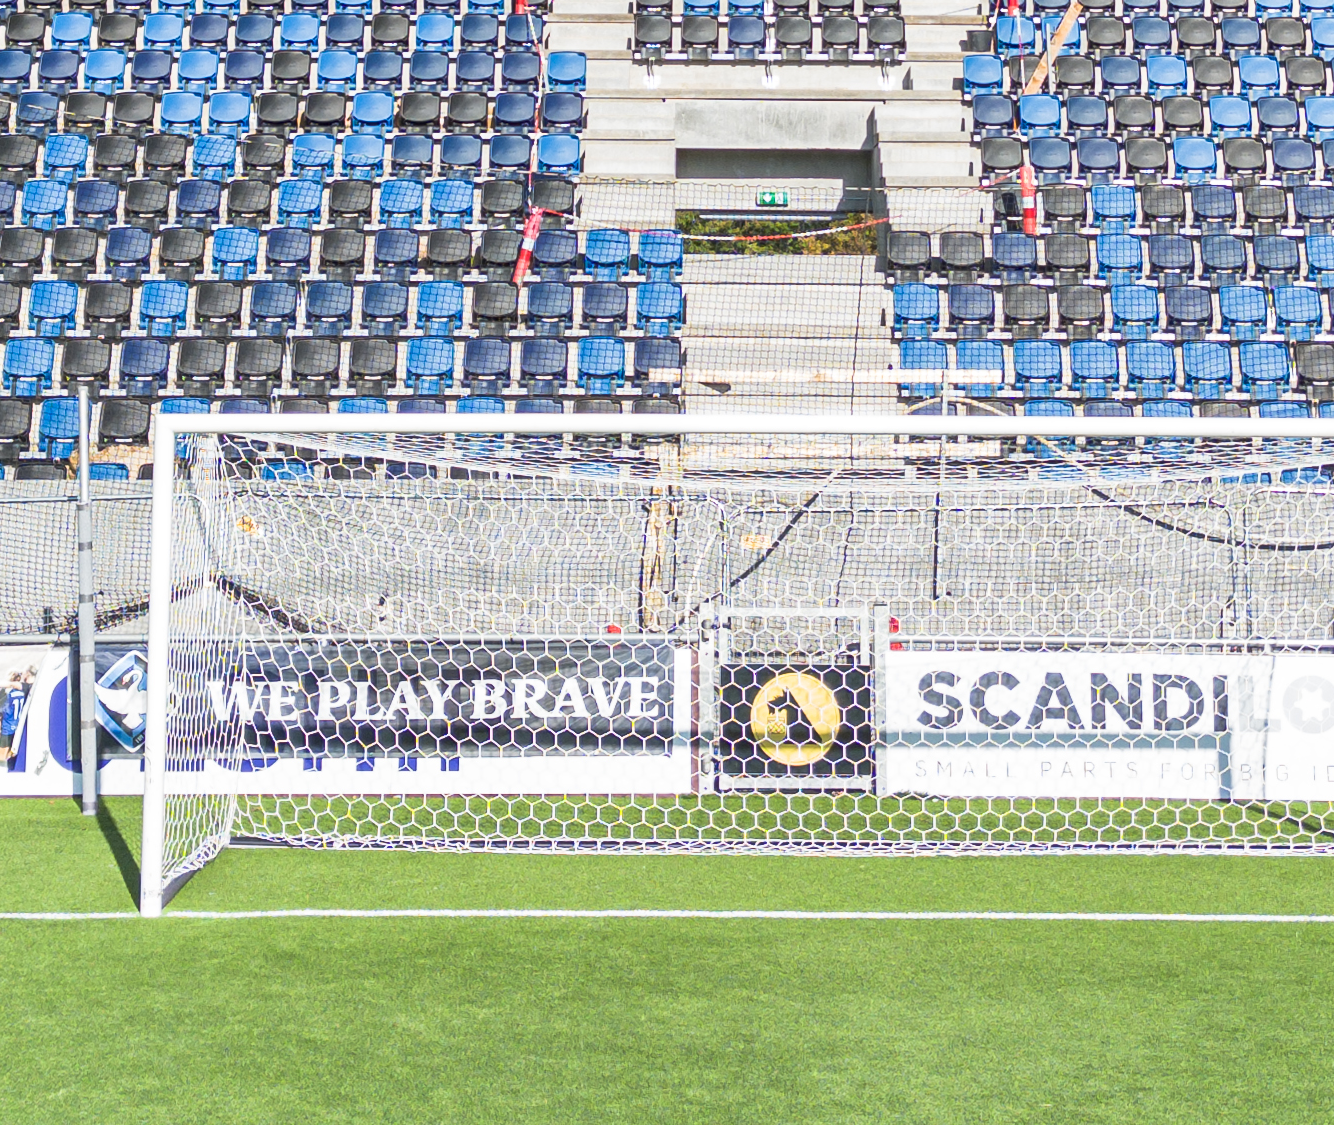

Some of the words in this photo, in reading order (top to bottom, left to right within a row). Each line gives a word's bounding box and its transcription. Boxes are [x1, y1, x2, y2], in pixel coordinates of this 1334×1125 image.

[208, 679, 298, 721] WE
[314, 678, 462, 721] PLAY
[469, 676, 660, 720] BRAVE
[915, 759, 1014, 779] SMALL
[1040, 760, 1139, 780] PARTS
[1161, 762, 1218, 781] FOR
